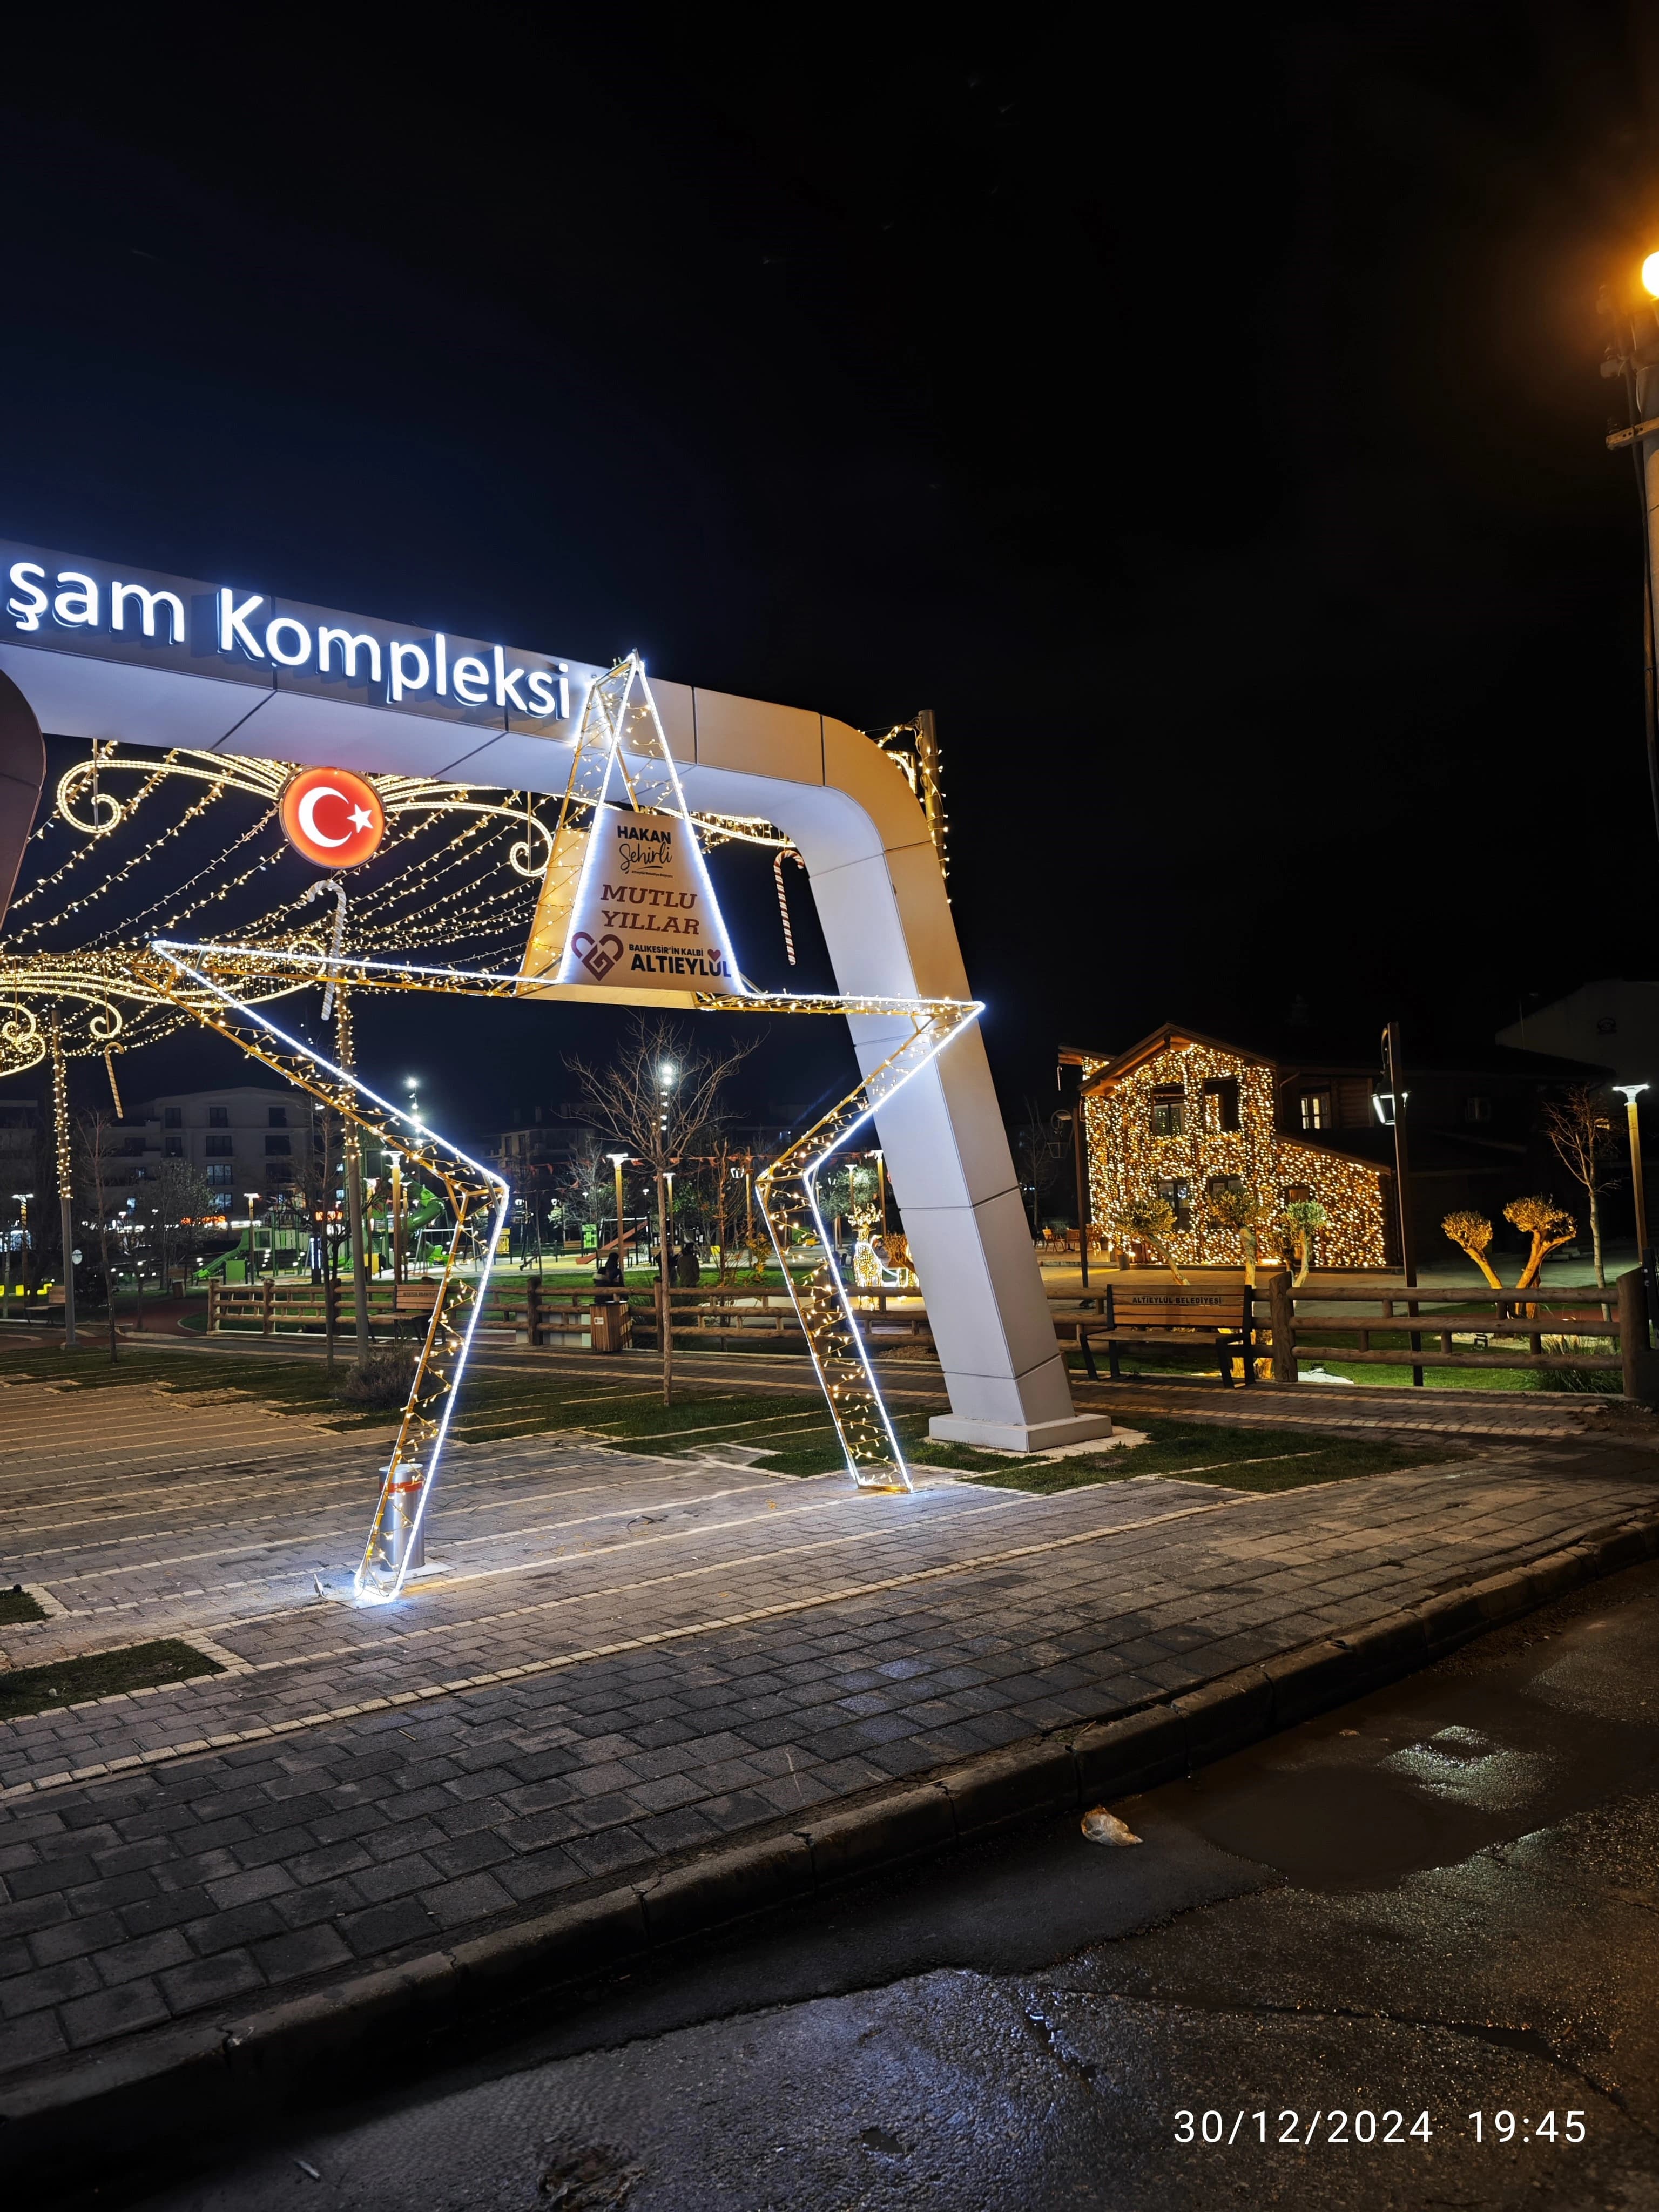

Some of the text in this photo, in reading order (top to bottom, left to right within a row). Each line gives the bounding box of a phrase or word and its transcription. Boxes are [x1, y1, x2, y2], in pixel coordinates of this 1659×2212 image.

[221, 587, 571, 719] Kompleksi
[617, 825, 671, 845] HAKAN
[619, 842, 672, 874] Şehirli
[600, 884, 697, 909] MUTLU
[601, 910, 700, 935] YILLAR
[680, 948, 703, 957] KALBİ
